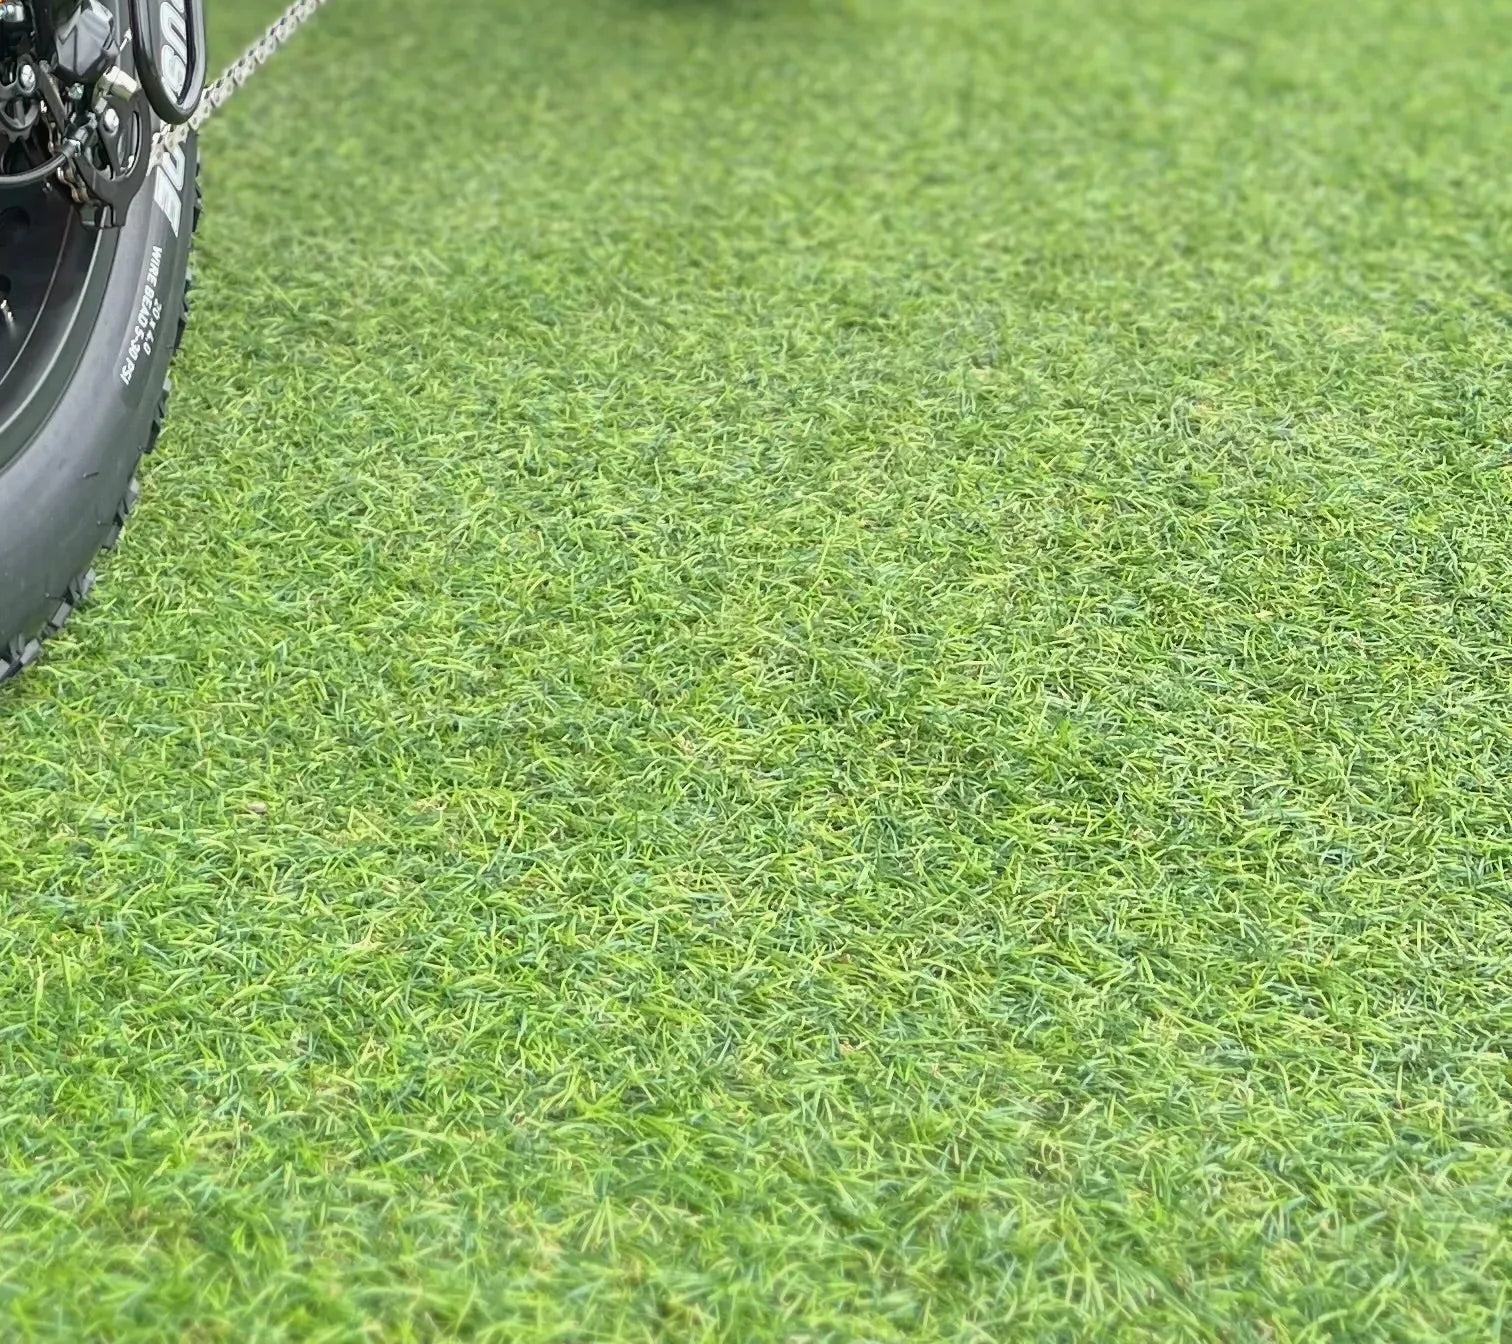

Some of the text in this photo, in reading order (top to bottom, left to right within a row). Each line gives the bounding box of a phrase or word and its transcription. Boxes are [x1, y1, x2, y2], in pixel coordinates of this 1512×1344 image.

[146, 245, 163, 288] WIRE
[137, 284, 155, 329] BEAD
[119, 357, 136, 386] PSI
